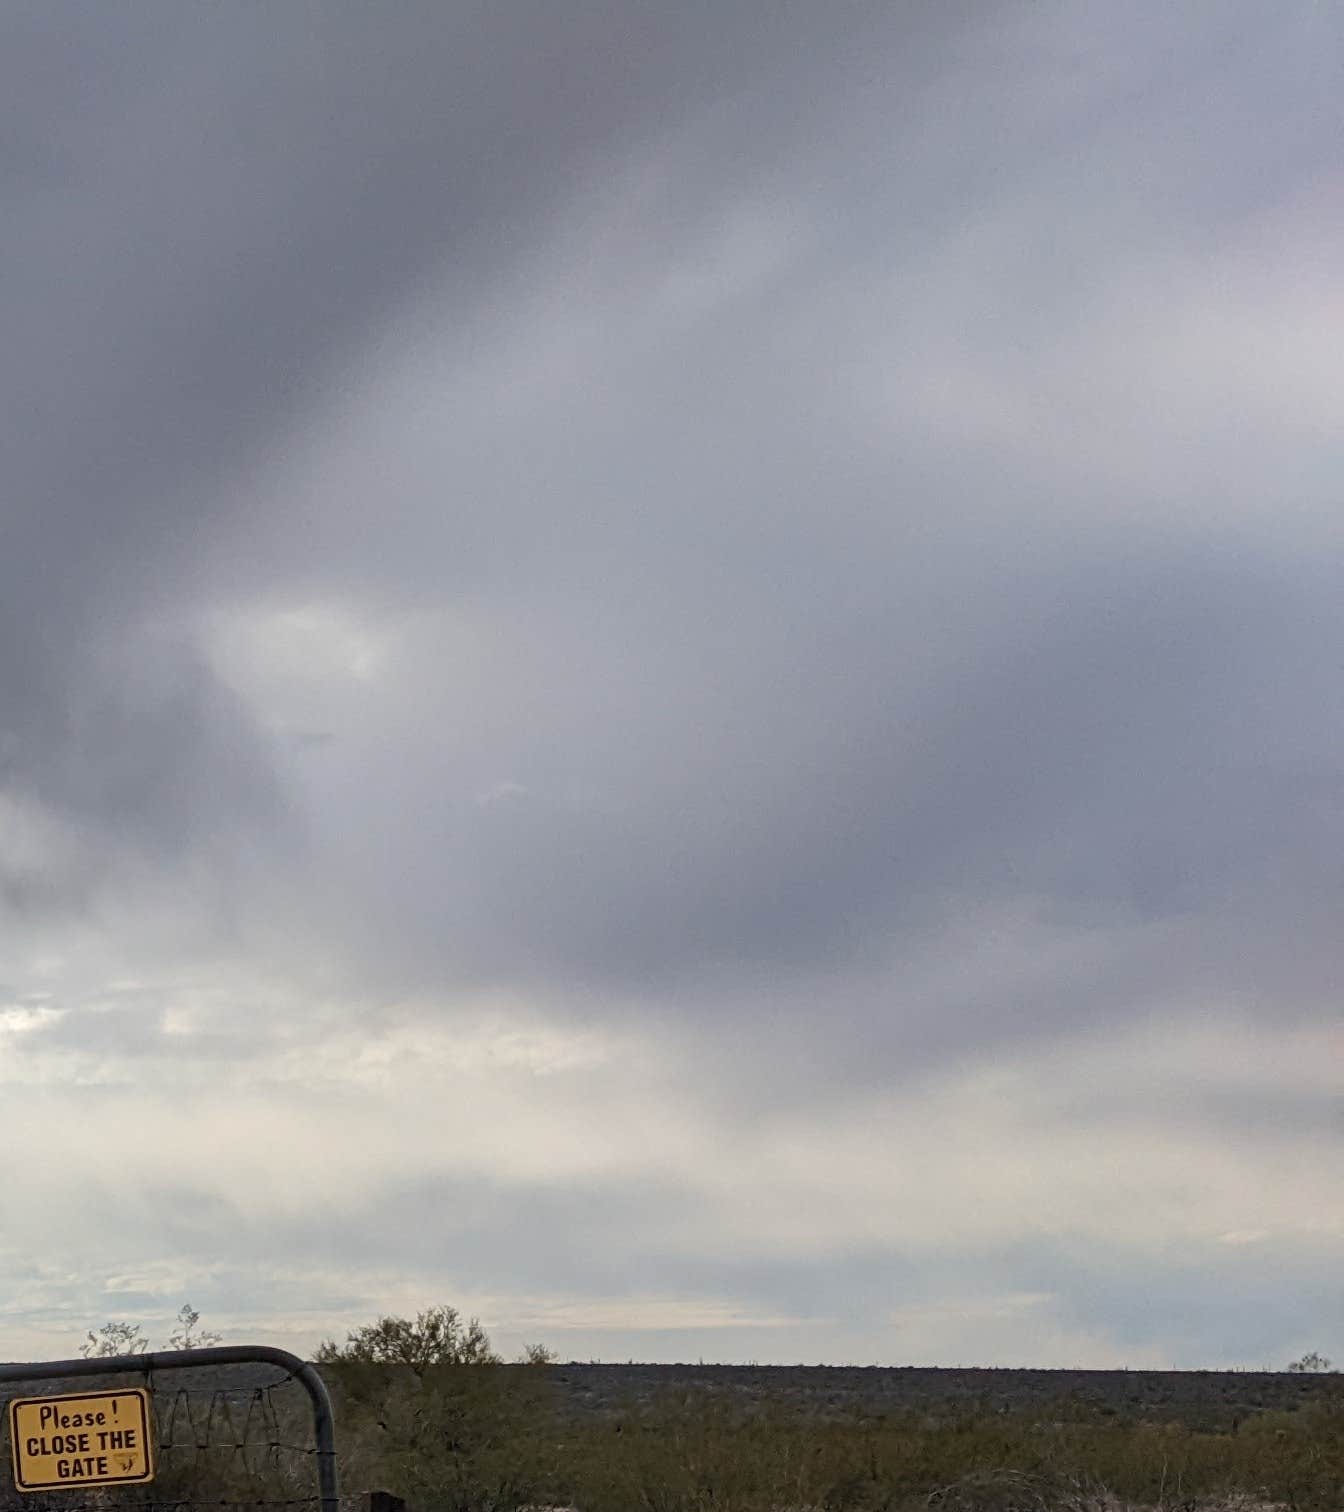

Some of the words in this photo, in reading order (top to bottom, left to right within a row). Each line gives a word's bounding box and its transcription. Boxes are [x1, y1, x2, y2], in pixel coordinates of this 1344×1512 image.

[26, 1433, 90, 1456] CLOSE
[96, 1429, 136, 1451] THE
[57, 1456, 109, 1478] GATE
